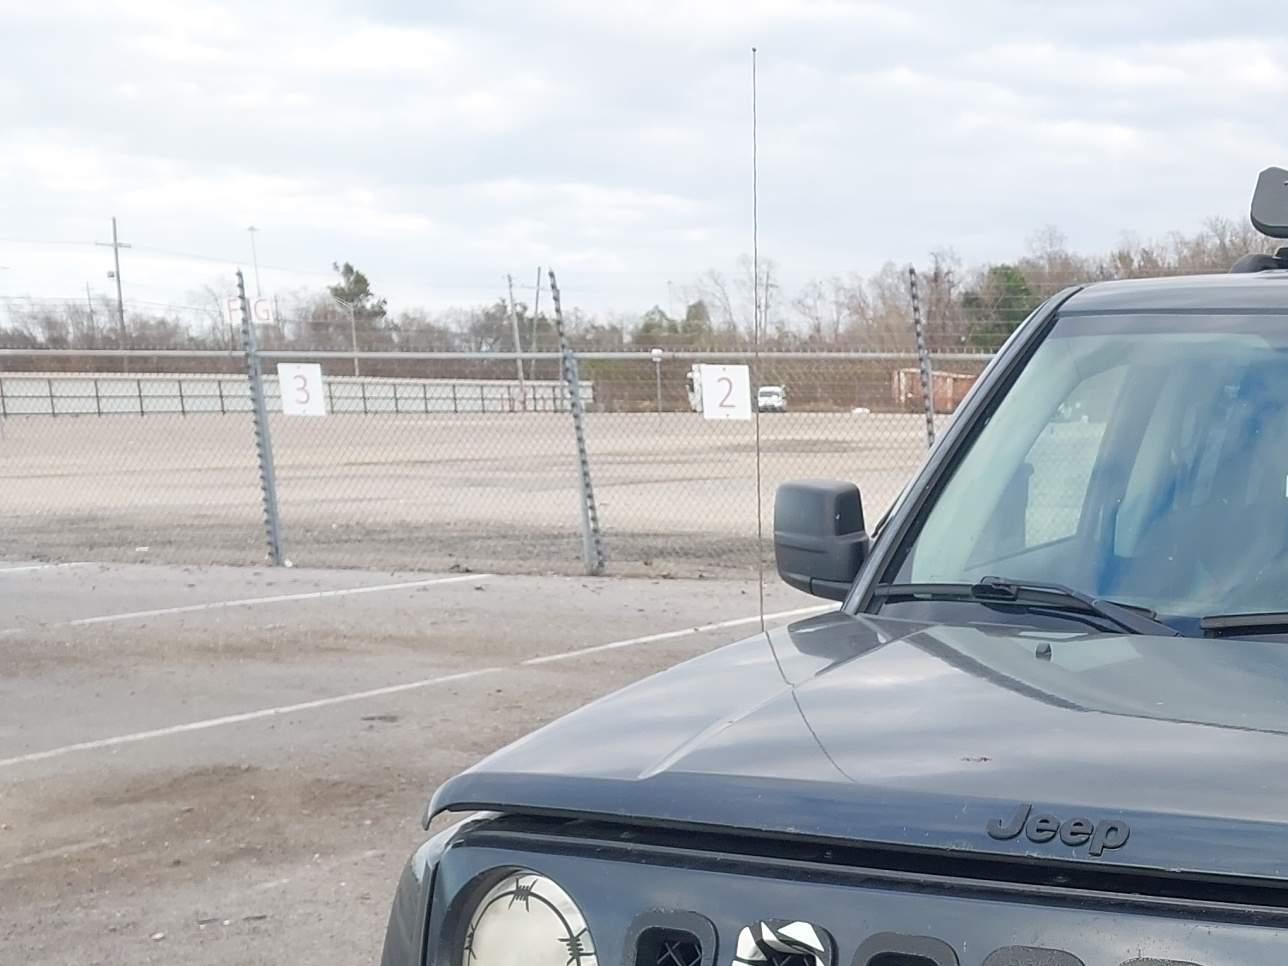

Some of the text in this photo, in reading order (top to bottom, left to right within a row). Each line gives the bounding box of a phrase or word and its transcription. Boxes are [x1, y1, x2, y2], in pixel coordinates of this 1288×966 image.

[293, 374, 310, 405] 3
[717, 377, 736, 408] 2
[986, 803, 1131, 857] Jeep
